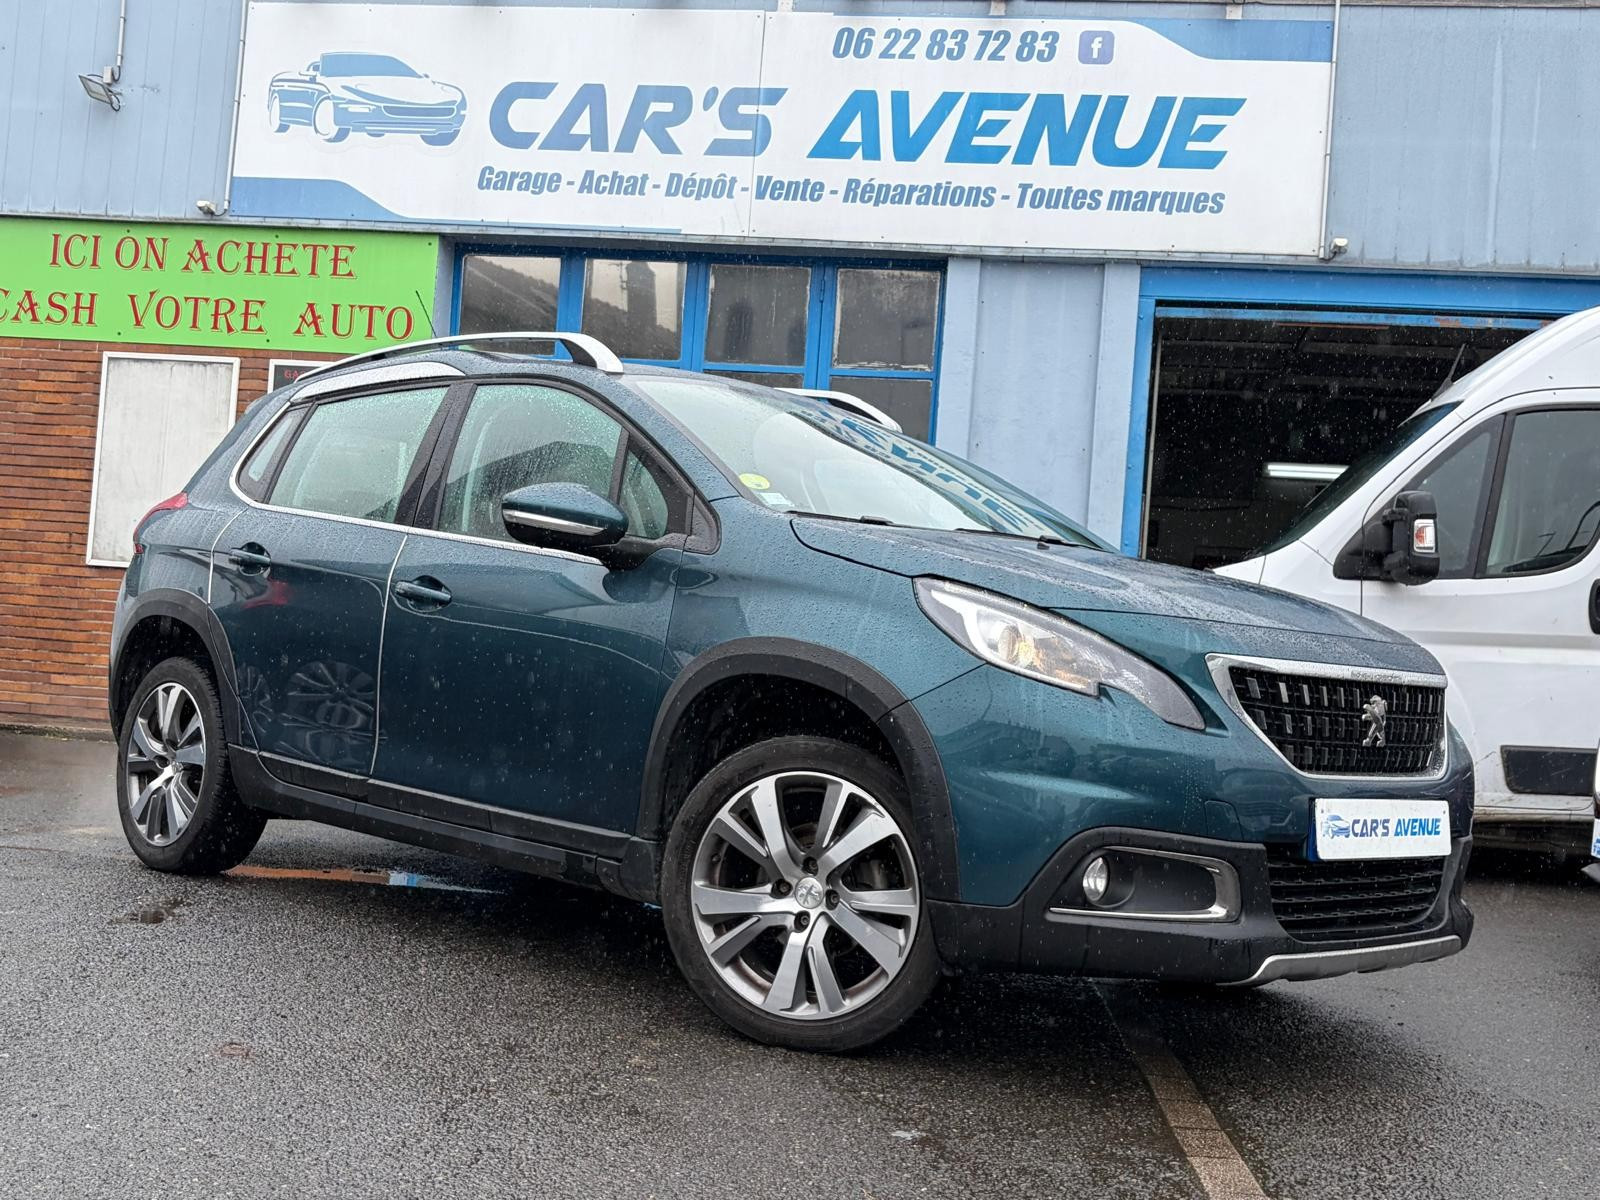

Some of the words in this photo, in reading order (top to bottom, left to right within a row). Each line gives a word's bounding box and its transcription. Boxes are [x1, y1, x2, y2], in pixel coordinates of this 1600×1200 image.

[832, 27, 876, 59] 06
[879, 28, 921, 60] 22
[926, 29, 968, 61] 83
[974, 30, 1011, 61] 72
[1016, 31, 1060, 62] 83
[490, 82, 788, 157] CAR'S
[807, 89, 1247, 170] AVENUE
[478, 166, 562, 195] Garage
[578, 170, 649, 196] Achat
[665, 173, 738, 201] Dépôt
[755, 176, 825, 202] Vente
[842, 178, 997, 208] Réparations
[1017, 183, 1101, 211] Toutes
[1106, 188, 1226, 216] marques
[50, 233, 101, 269] ICI
[115, 235, 168, 271] ON
[182, 239, 357, 279] ACHETE
[128, 289, 267, 335] VOTRE
[294, 302, 415, 340] AUTO
[1351, 818, 1391, 838] CAR'S
[1393, 817, 1441, 837] AVENUE
